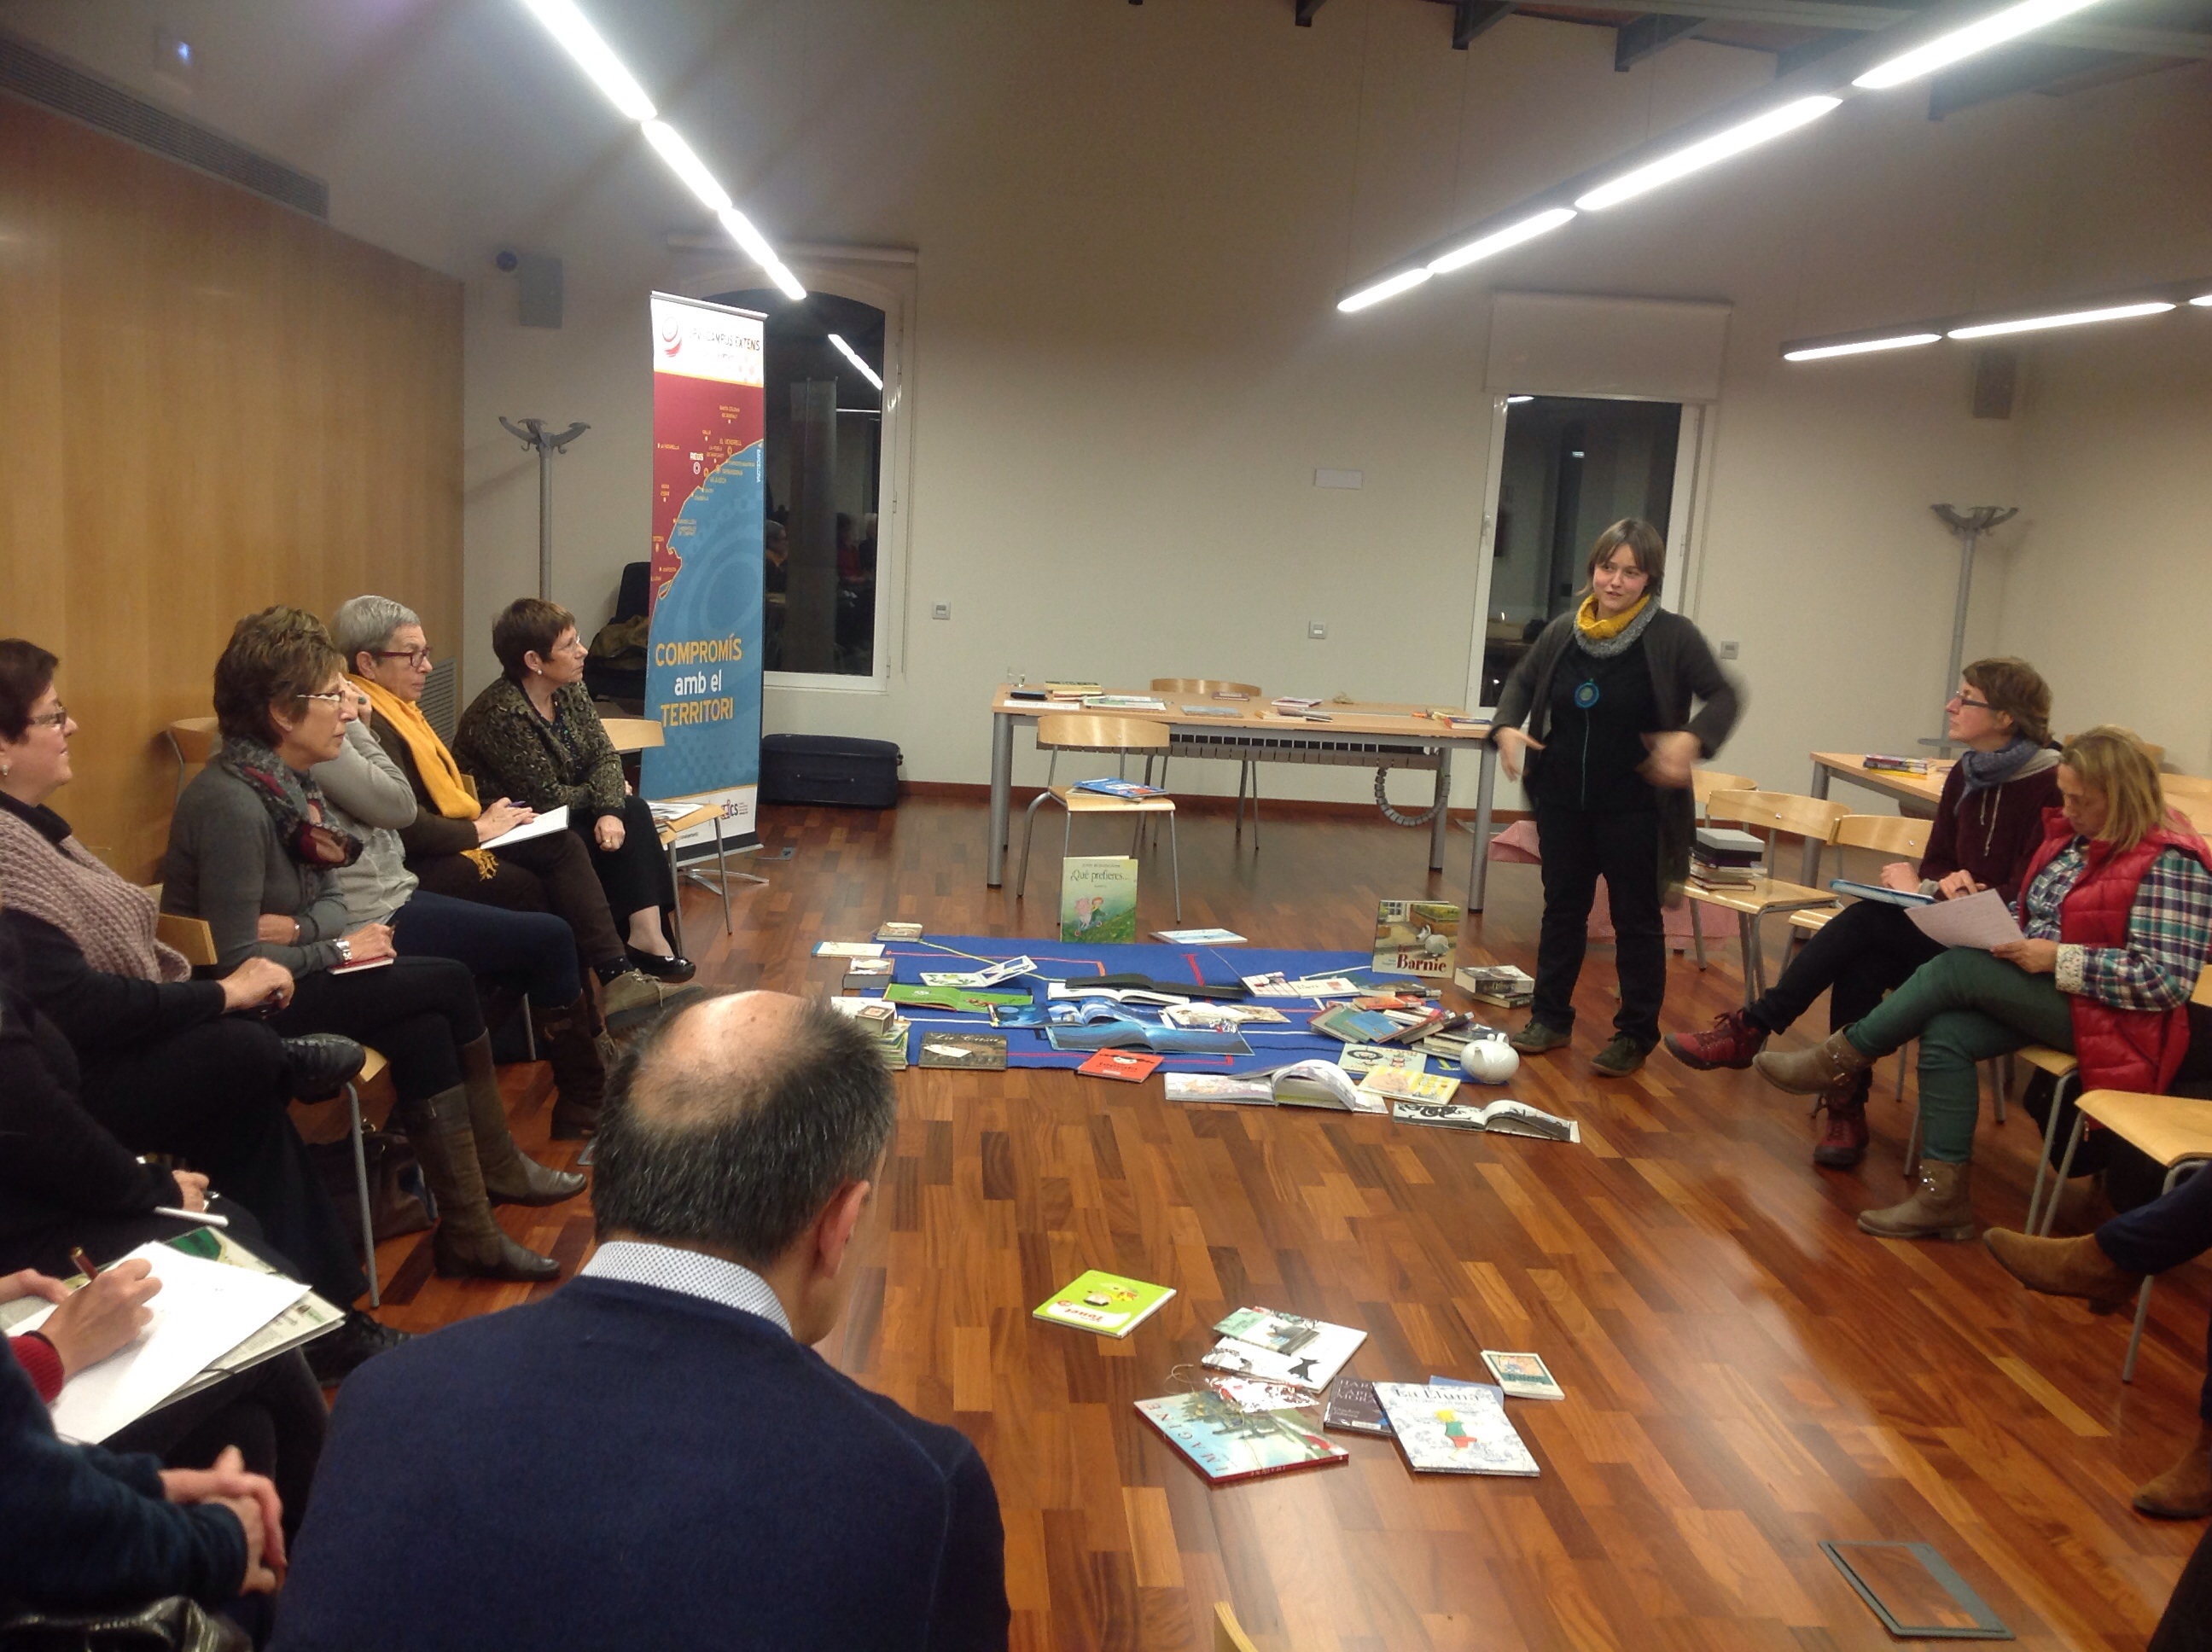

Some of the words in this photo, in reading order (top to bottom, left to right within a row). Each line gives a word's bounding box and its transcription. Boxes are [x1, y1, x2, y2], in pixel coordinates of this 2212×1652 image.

[655, 633, 743, 667] COMPROMÍS
[674, 671, 707, 696] amb
[710, 668, 723, 693] el
[661, 696, 734, 728] TERRITORI
[1397, 953, 1447, 973] Barnie
[1145, 1401, 1230, 1474] IMAGINE
